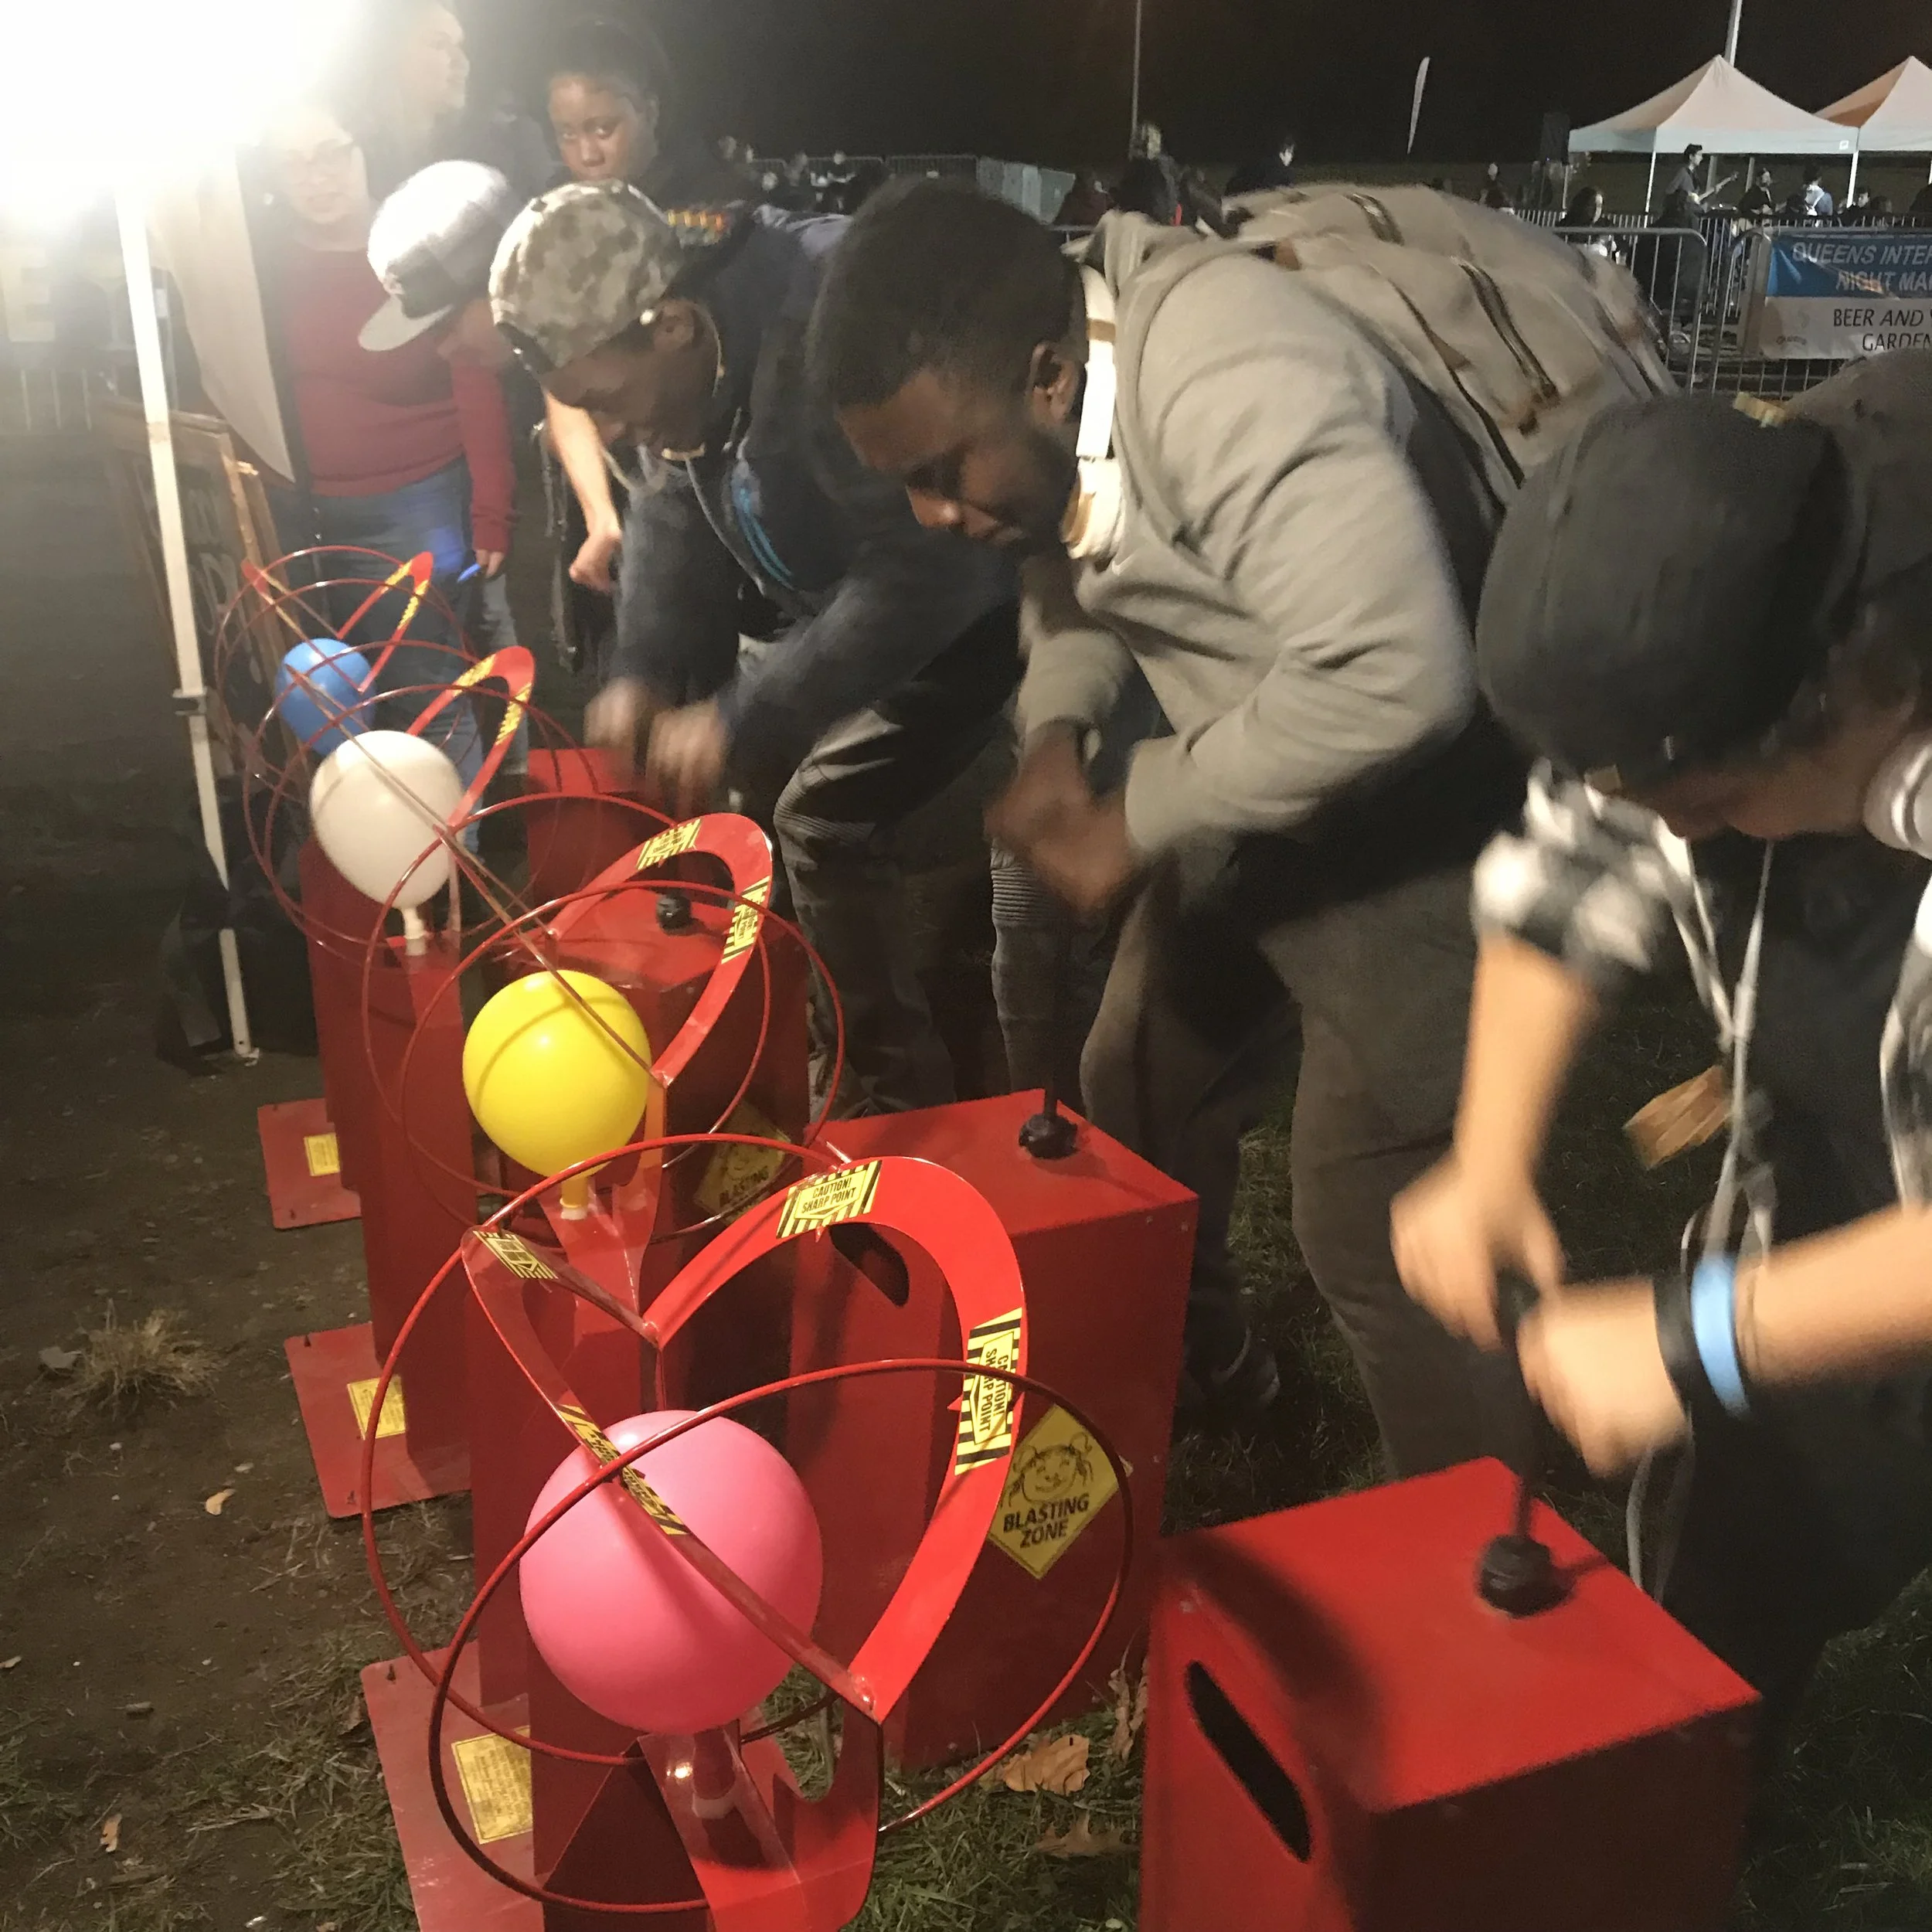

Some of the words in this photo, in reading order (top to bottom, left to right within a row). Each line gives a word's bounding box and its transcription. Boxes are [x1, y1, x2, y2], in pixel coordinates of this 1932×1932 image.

[1792, 242, 1877, 264] QUEENS
[1833, 308, 1875, 327] BEER
[1879, 309, 1924, 327] AND
[801, 1196, 830, 1214] SHARP
[830, 1187, 856, 1206] POINT
[812, 1177, 852, 1199] CAUTION!
[983, 1348, 998, 1391] SHP
[993, 1355, 1009, 1417] CTION!
[978, 1393, 994, 1433] POINT
[1003, 1492, 1090, 1533] BLASTING
[1019, 1518, 1070, 1548] ZONE
